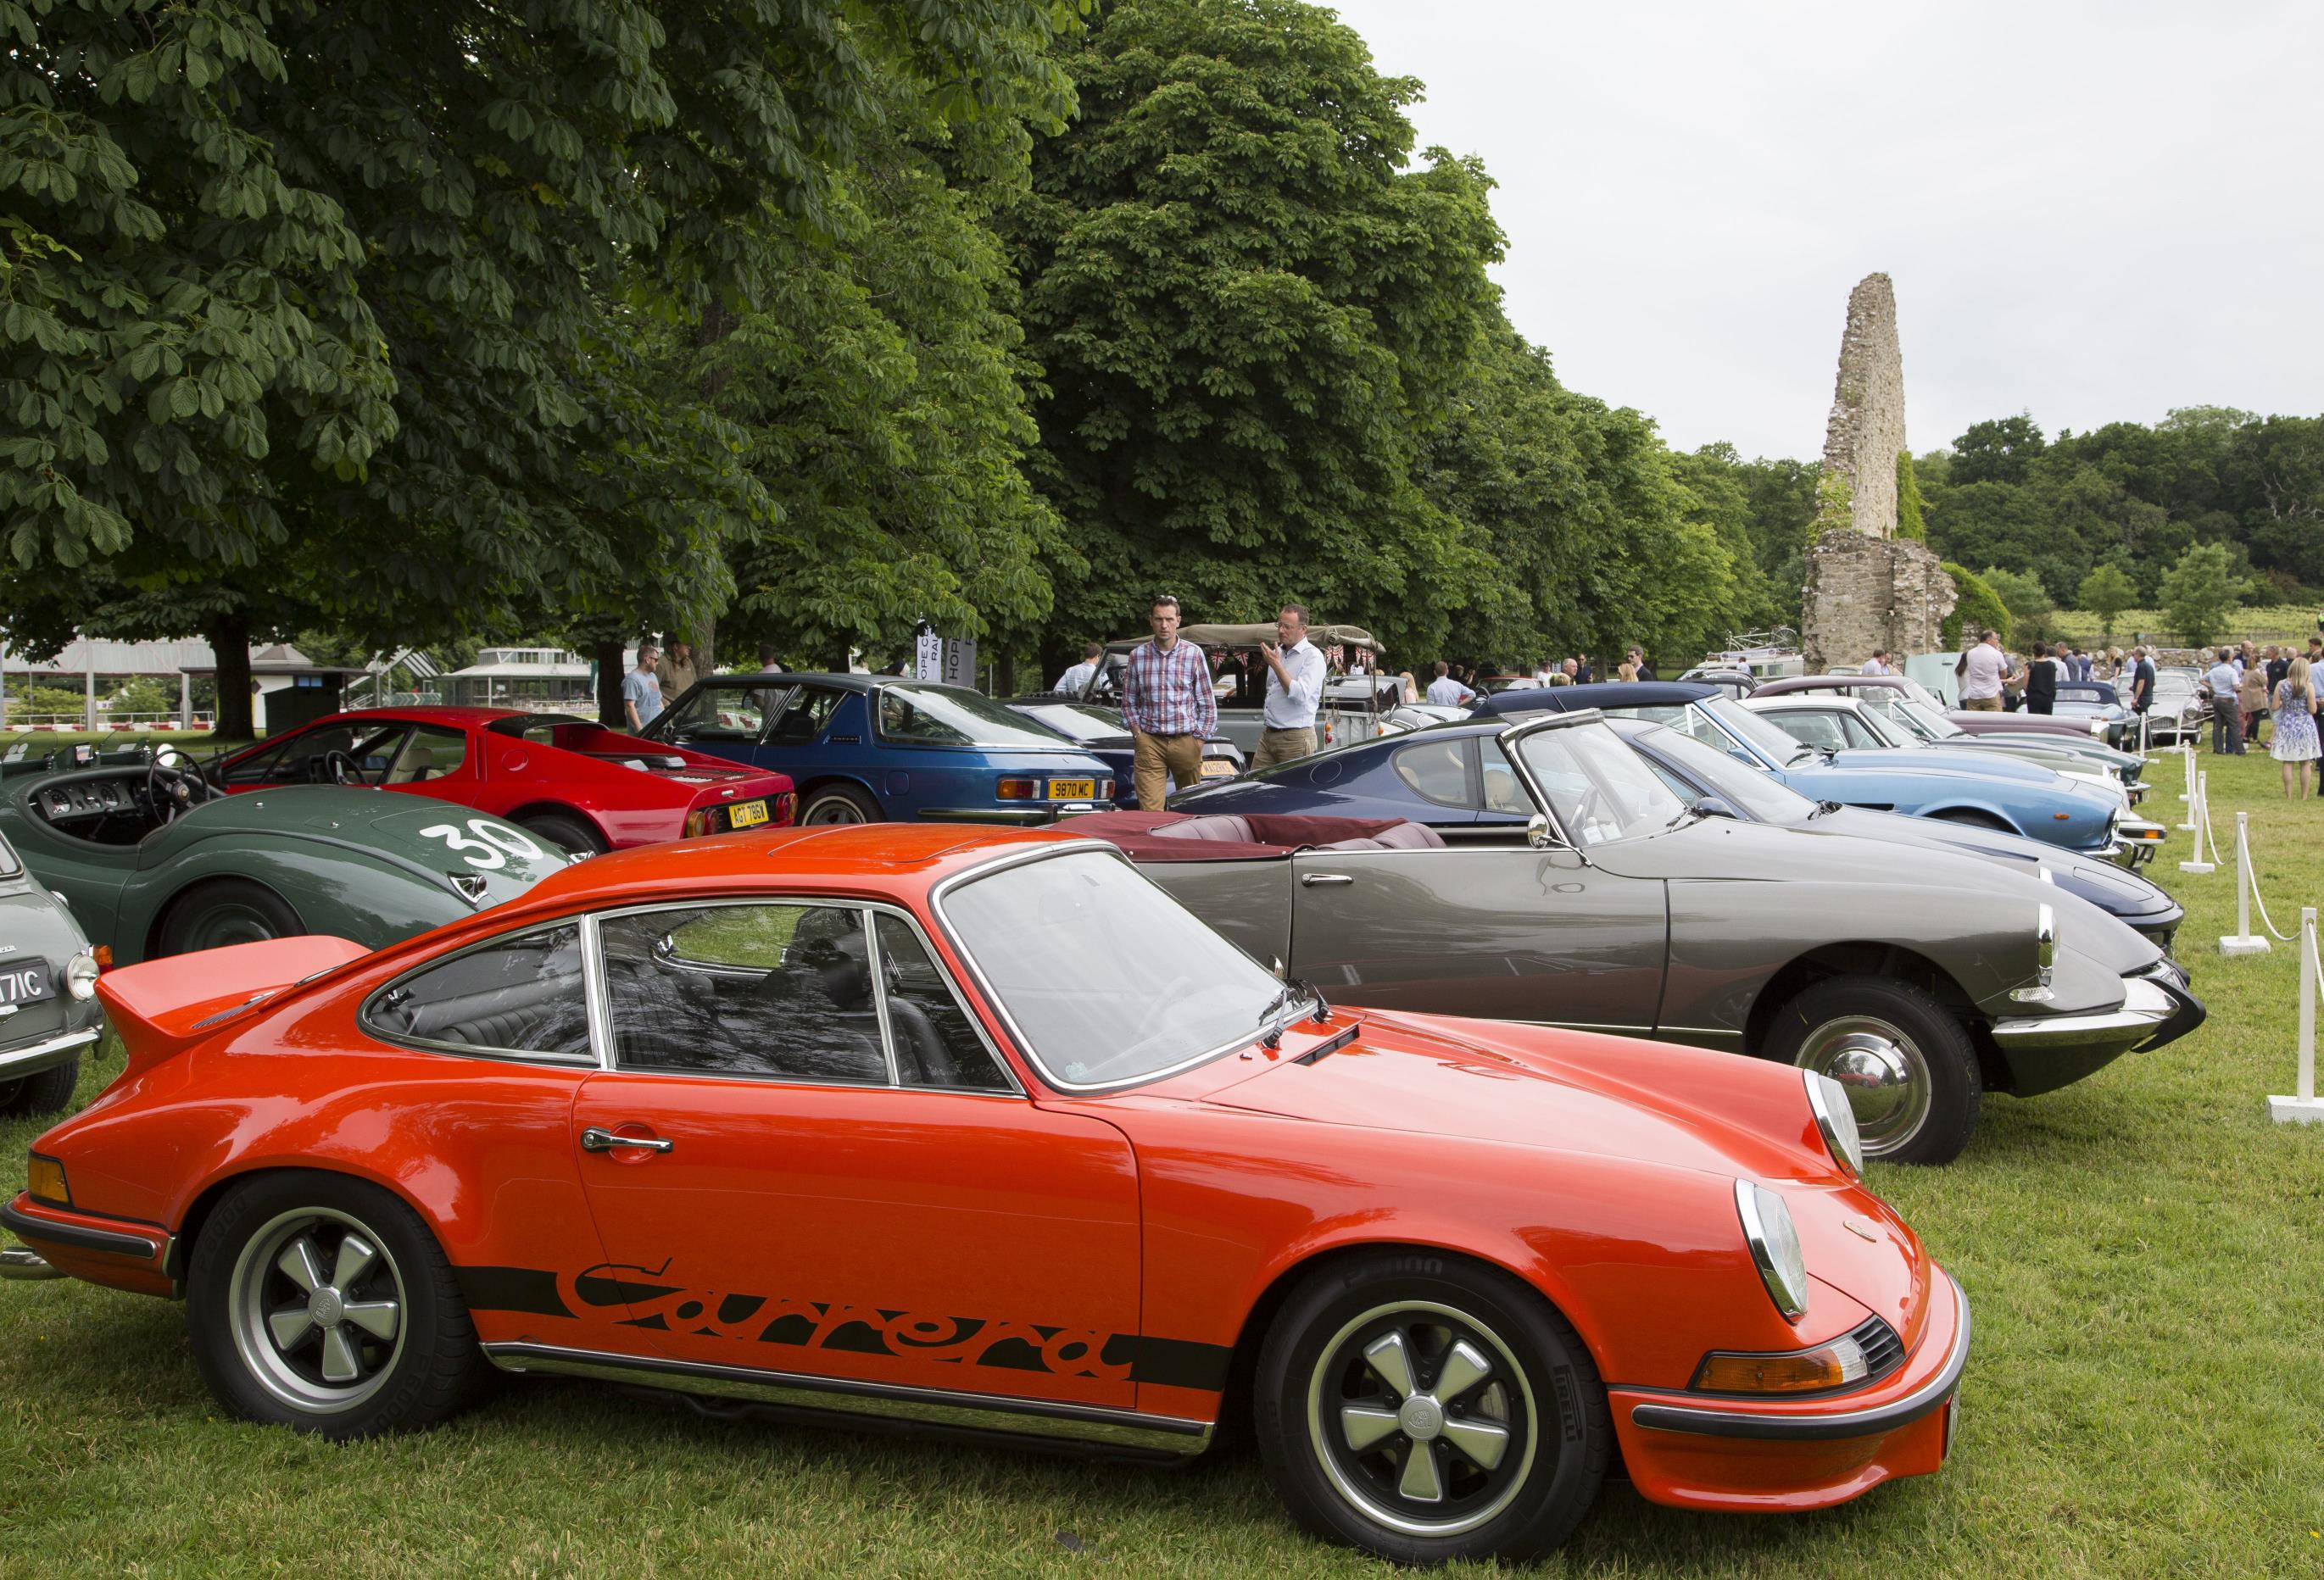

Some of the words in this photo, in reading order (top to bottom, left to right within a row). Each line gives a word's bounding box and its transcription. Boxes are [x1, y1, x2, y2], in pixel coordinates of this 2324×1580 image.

[1056, 782, 1077, 797] 9870
[1078, 782, 1090, 797] MC
[733, 807, 747, 825] AGT
[419, 819, 543, 870] 30
[555, 1258, 1134, 1382] Carrera
[1553, 1364, 1584, 1444] PIRELLI
